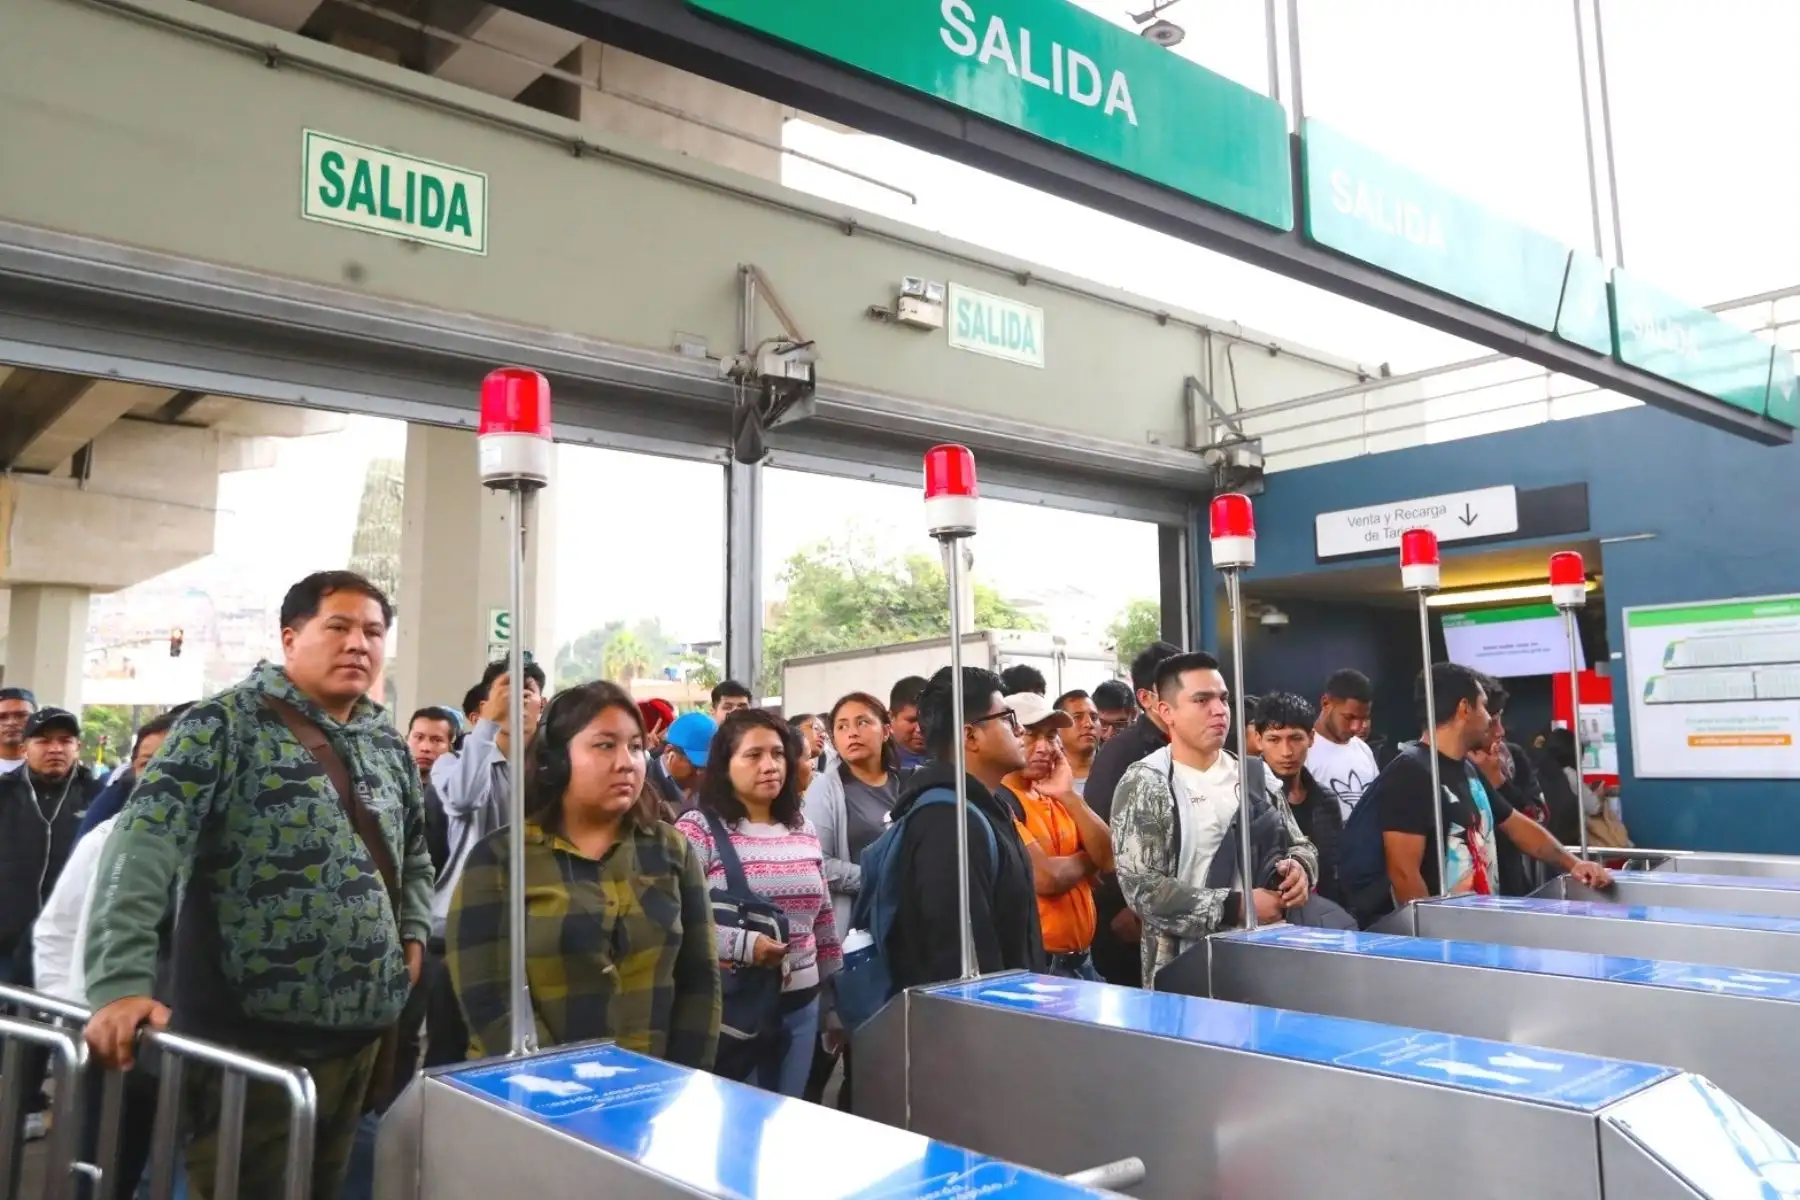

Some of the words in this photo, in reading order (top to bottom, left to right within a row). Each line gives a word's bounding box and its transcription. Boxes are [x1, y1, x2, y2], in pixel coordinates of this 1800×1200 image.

[939, 0, 1138, 126] SALIDA
[318, 150, 472, 237] SALIDA
[1330, 169, 1447, 255] SALIDA
[957, 297, 1036, 355] SALIDA
[1347, 513, 1381, 527] Venta
[1383, 511, 1391, 526] y
[1394, 504, 1447, 521] Recarga
[1364, 529, 1380, 542] de
